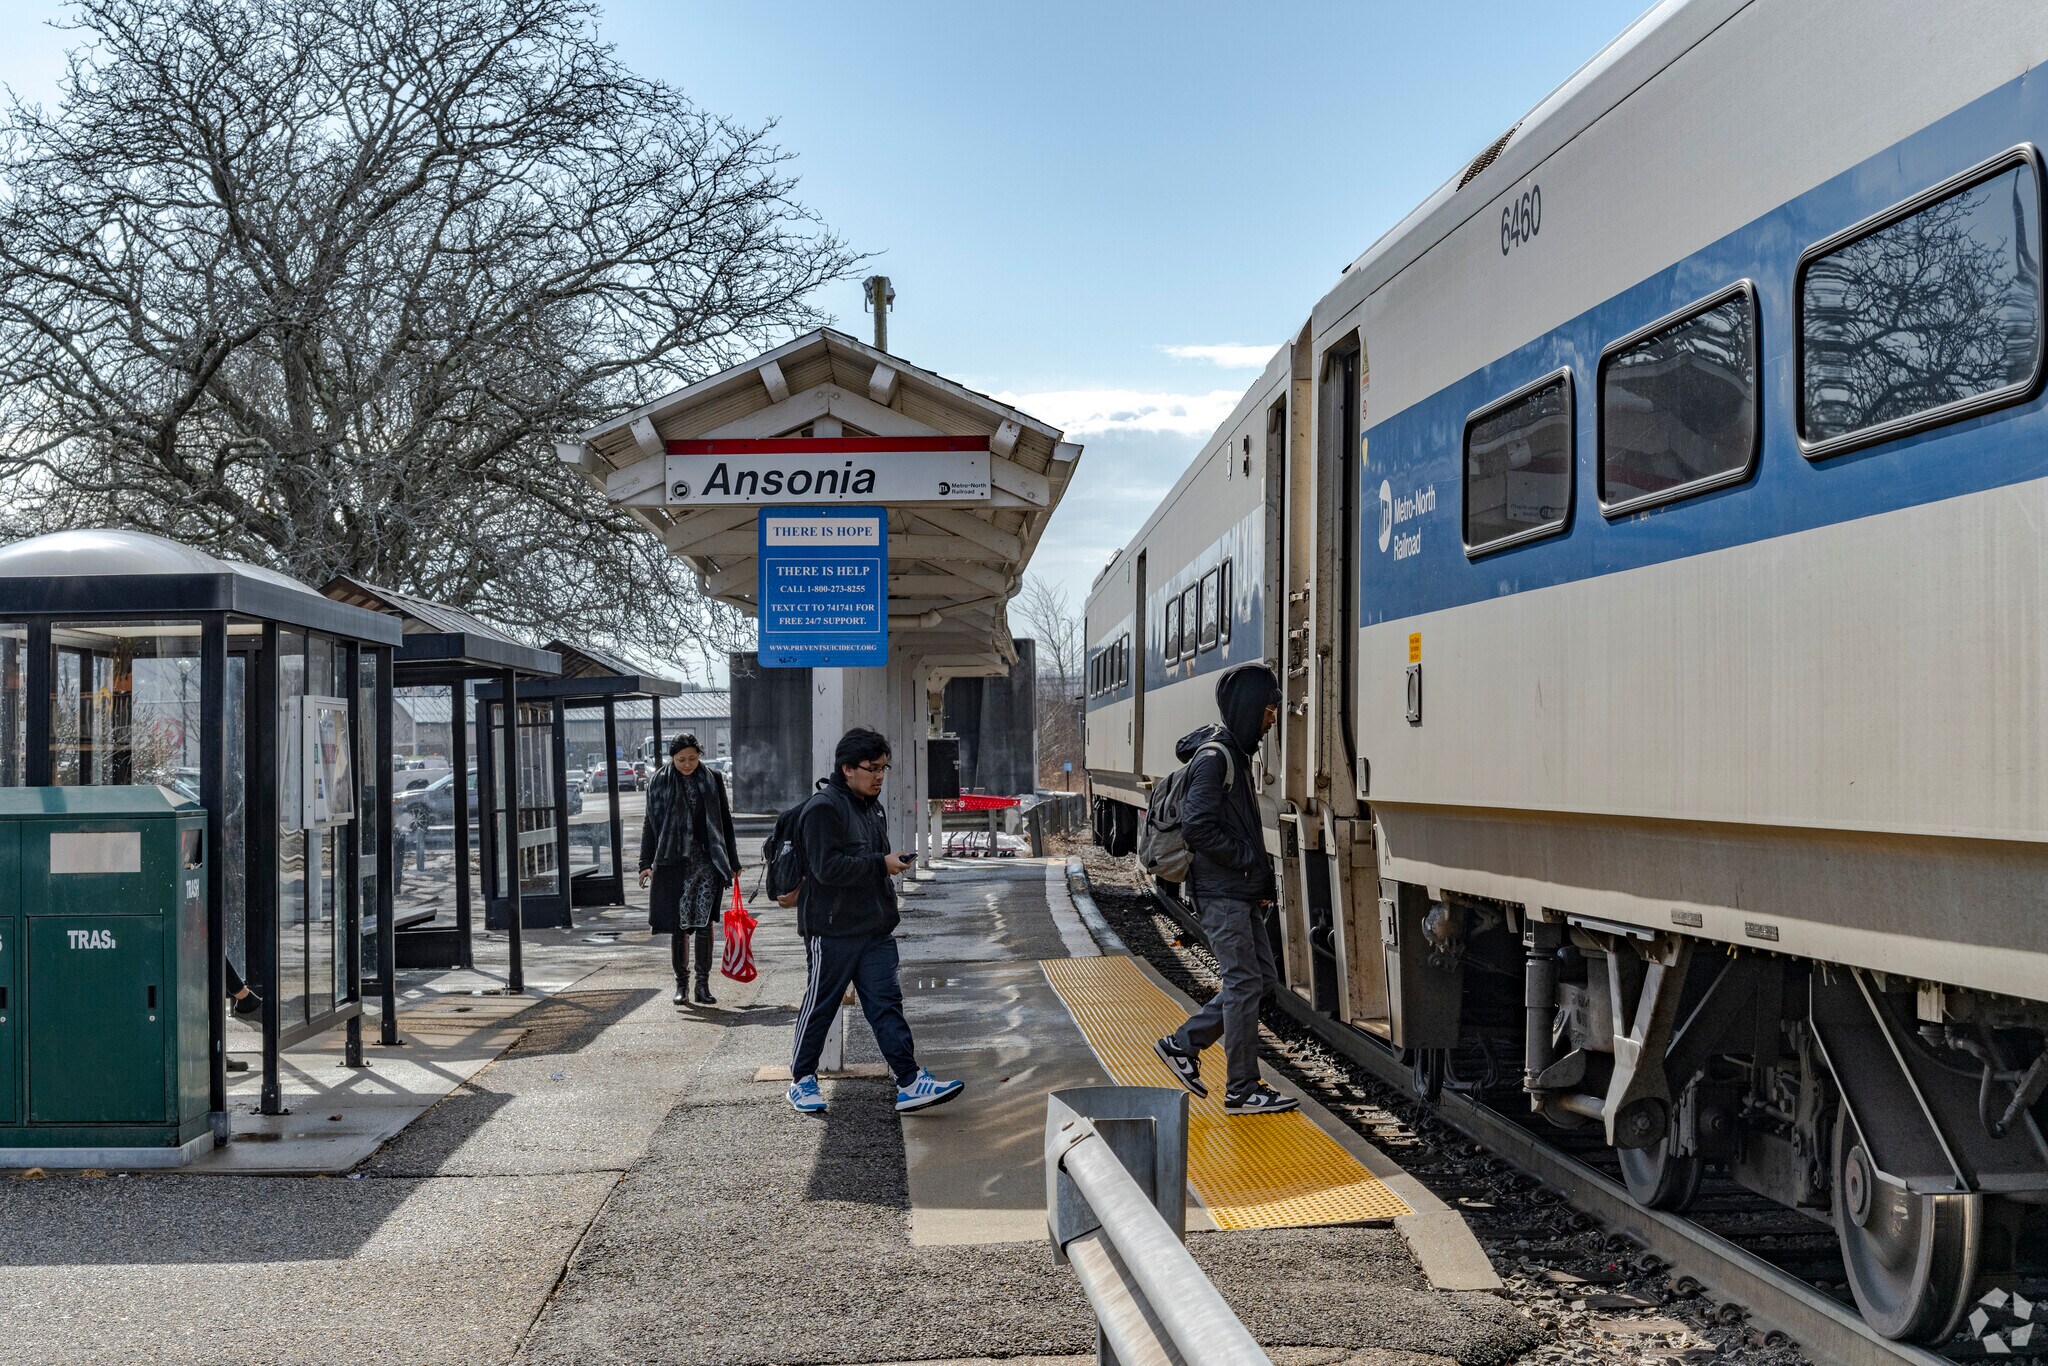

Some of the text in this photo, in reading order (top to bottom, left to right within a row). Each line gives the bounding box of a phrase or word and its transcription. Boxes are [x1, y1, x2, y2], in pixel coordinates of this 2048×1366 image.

[1501, 184, 1542, 256] 6460
[701, 461, 876, 496] Ansonia
[1394, 483, 1436, 525] Metro-North
[773, 526, 873, 537] THERE IS HOPE
[1393, 527, 1421, 561] Railroad
[776, 566, 870, 576] THERE IS HELP
[780, 585, 866, 593] CALL 1-800-273-8255
[770, 603, 875, 612] TEXT CT TO 741741 FOR
[779, 617, 867, 625] FREE 24/7 SUPPORT.
[769, 644, 877, 652] WWW.PREVENTSUICIDECT.ORG
[186, 878, 200, 899] TRASH
